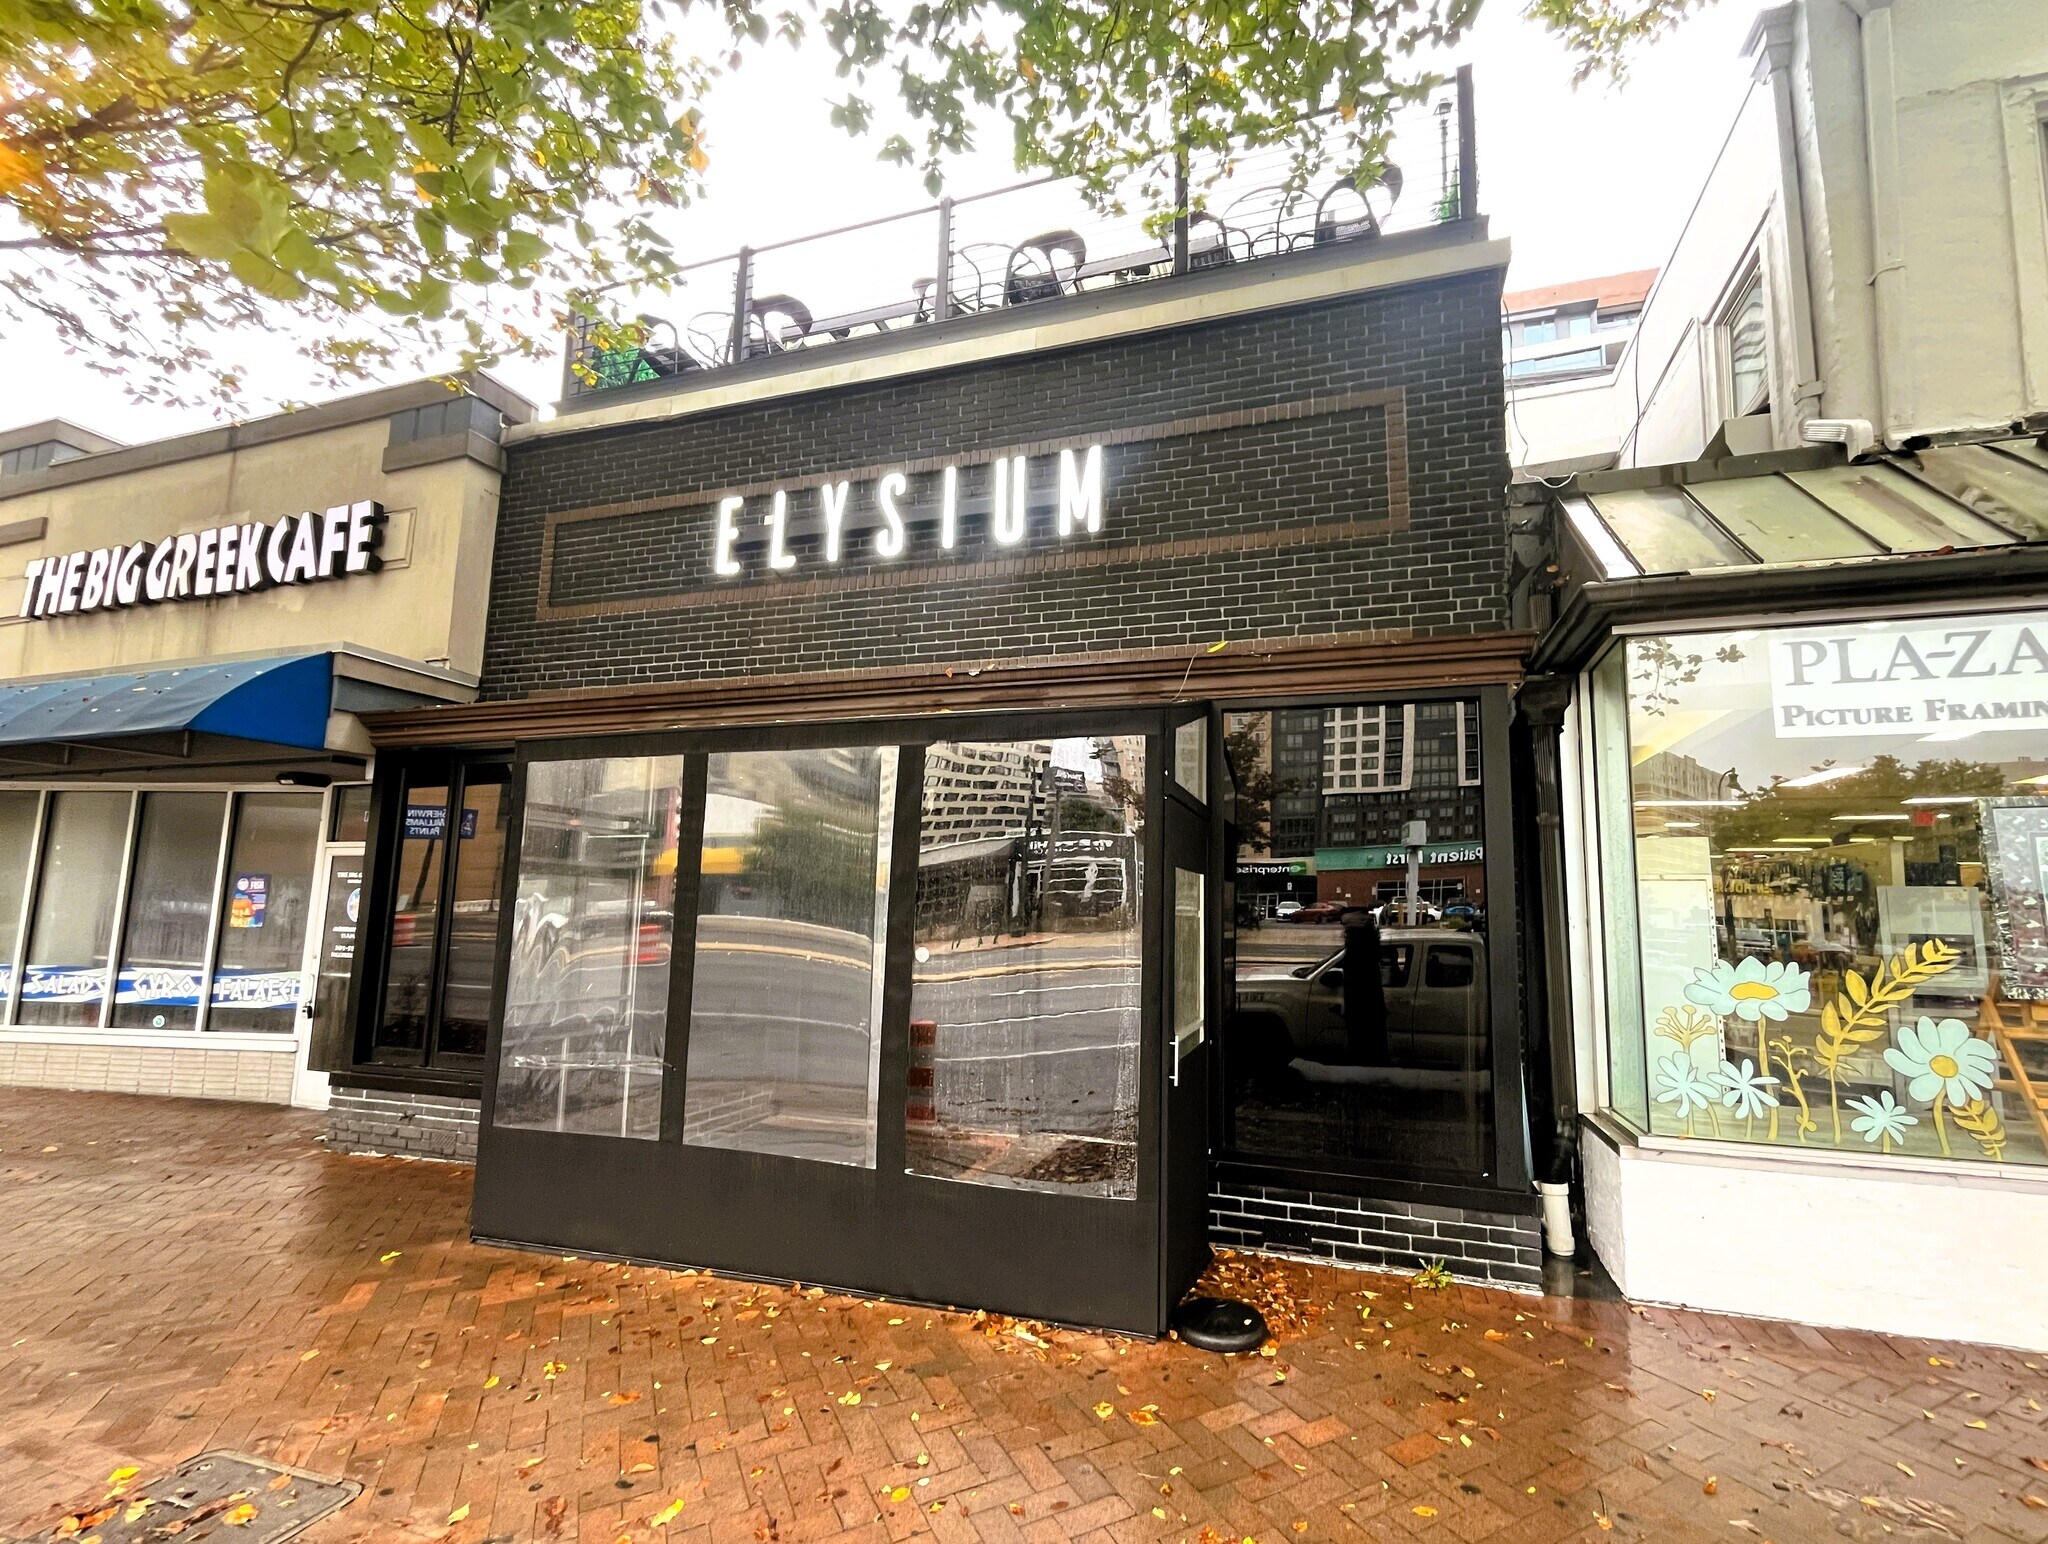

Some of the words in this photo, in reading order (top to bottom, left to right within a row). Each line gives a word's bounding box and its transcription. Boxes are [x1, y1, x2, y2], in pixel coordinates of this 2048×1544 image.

[715, 445, 1102, 575] ELYSIUM
[20, 551, 93, 618] THE
[80, 541, 148, 611] BIG
[147, 521, 270, 601] GREEK
[267, 500, 384, 585] CAFE
[1782, 627, 2048, 686] PLA-ZA
[1781, 704, 1913, 727] PICTURE
[31, 972, 106, 995] SALADS
[132, 972, 199, 999] GYRO
[218, 977, 300, 1002] FALAFEL
